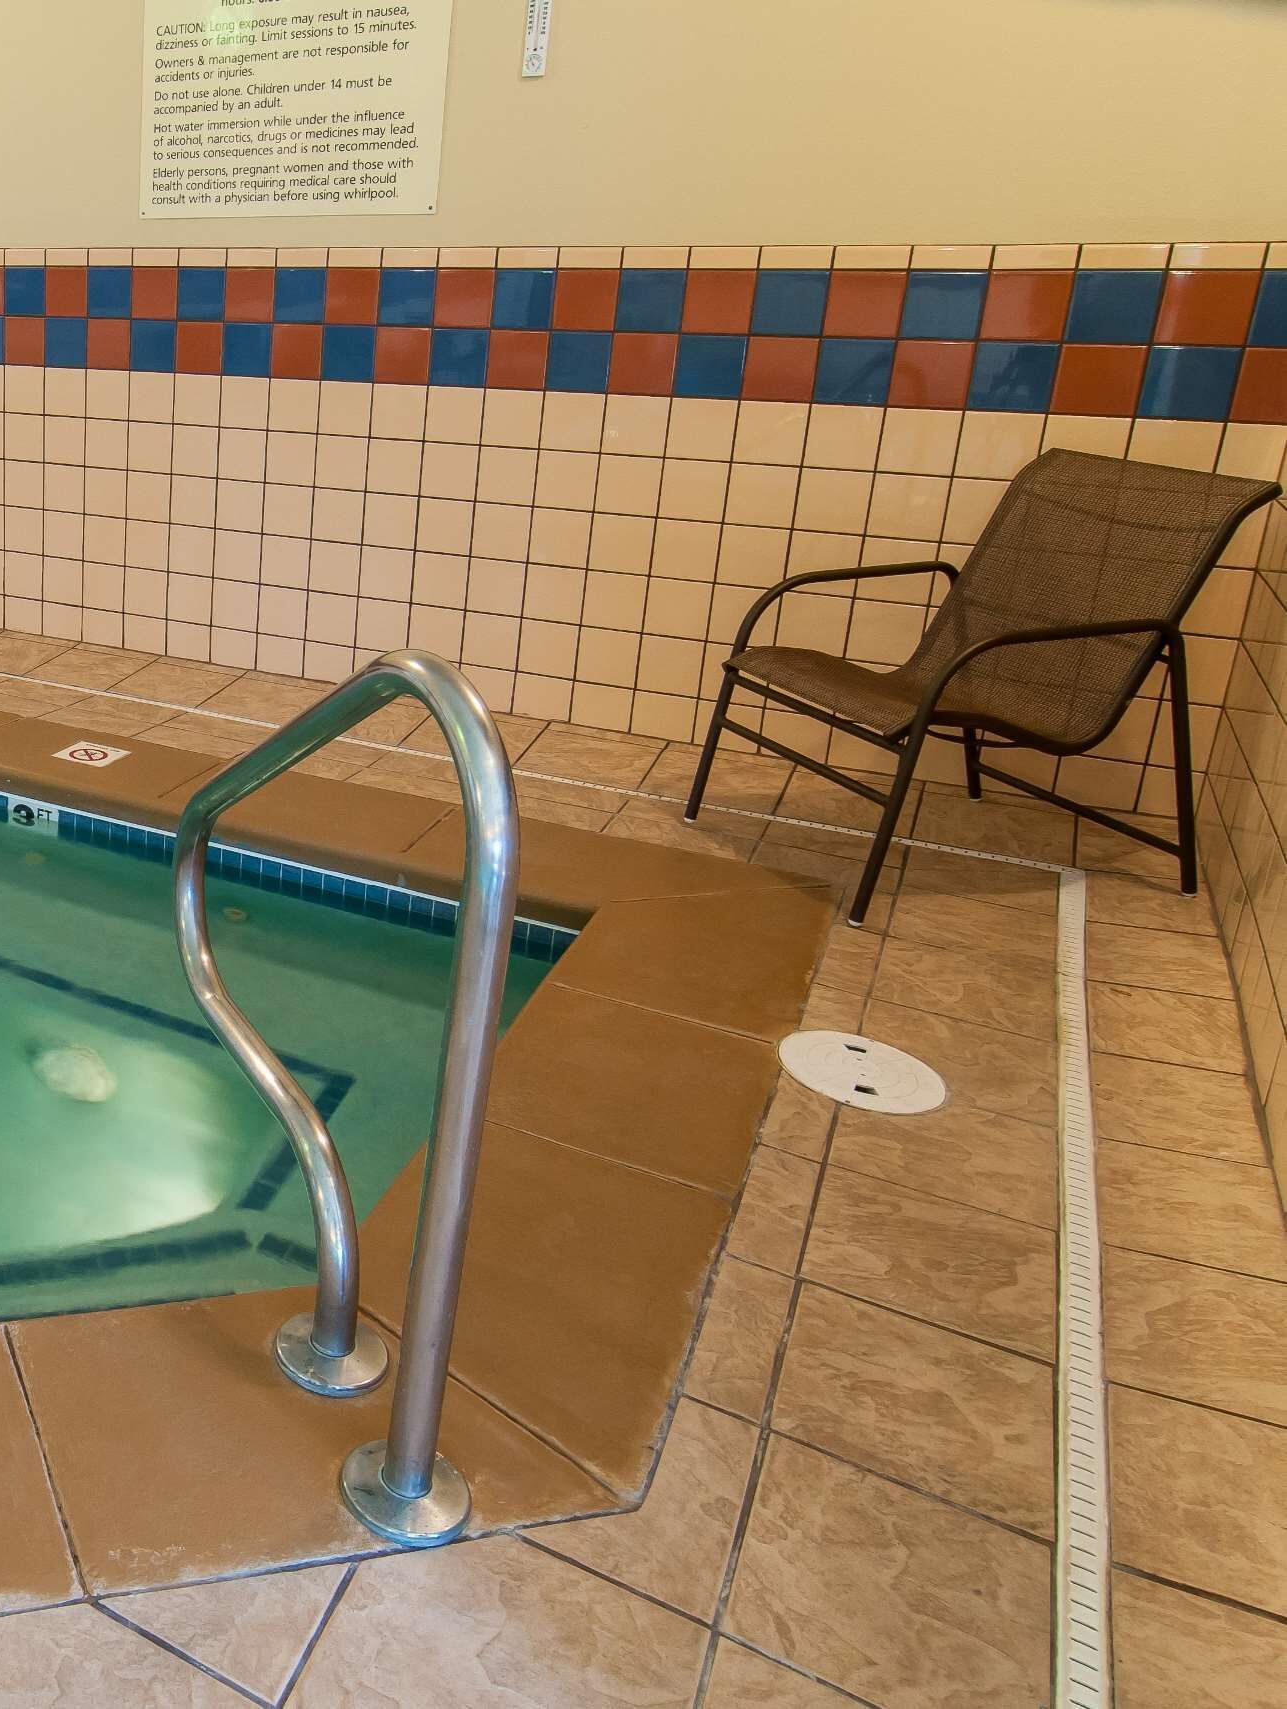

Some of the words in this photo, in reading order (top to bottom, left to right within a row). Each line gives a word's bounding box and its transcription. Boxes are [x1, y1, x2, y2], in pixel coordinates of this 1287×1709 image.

[209, 20, 235, 34] Long
[239, 15, 287, 31] exposure
[291, 14, 313, 27] may
[318, 9, 348, 23] result
[352, 9, 362, 20] in
[366, 5, 409, 19] nausea,
[156, 36, 198, 51] dizziness
[202, 36, 213, 47] or
[216, 33, 258, 47] fainting.
[261, 30, 287, 42] Limit
[291, 26, 333, 39] sessions
[337, 24, 348, 36] to
[354, 22, 365, 34] 15
[369, 19, 417, 33] minutes.
[155, 56, 194, 69] Owners
[198, 55, 205, 66] &
[209, 50, 278, 65] management
[282, 49, 298, 59] are
[303, 45, 322, 58] not
[325, 41, 388, 57] responsible
[392, 39, 409, 51] for
[154, 70, 199, 83] accidents
[203, 70, 214, 79] or
[218, 66, 254, 80] injuries.
[154, 91, 168, 101] Do
[172, 89, 189, 100] not
[193, 89, 209, 98] use
[213, 85, 242, 97] alone.
[247, 83, 289, 95] Children
[293, 80, 325, 92] under
[330, 79, 342, 89] 14
[346, 77, 374, 88] must
[378, 75, 392, 87] be
[154, 102, 218, 117] accompanied
[222, 100, 234, 111] by
[238, 101, 250, 109] an
[254, 97, 282, 108] adult.
[154, 123, 172, 133] Hot
[175, 122, 204, 132] water
[207, 118, 260, 130] immersion
[264, 116, 291, 128] while
[295, 113, 328, 125] under
[331, 112, 350, 123] the
[354, 109, 404, 122] influence
[154, 134, 163, 146] of
[167, 132, 202, 146] alcohol,
[207, 130, 253, 144] narcotics,
[257, 129, 286, 142] drugs
[290, 130, 301, 140] or
[305, 125, 358, 139] medicines
[362, 126, 386, 139] may
[390, 123, 414, 135] lead
[154, 150, 163, 160] to
[166, 148, 200, 159] serious
[203, 145, 273, 161] consequences
[277, 143, 297, 155] and
[301, 142, 308, 153] is
[312, 142, 330, 152] not
[334, 138, 418, 151] recommended.
[153, 166, 184, 179] Elderly
[188, 167, 228, 179] persons,
[232, 163, 280, 177] pregnant
[283, 163, 323, 173] women
[328, 160, 349, 171] and
[352, 158, 383, 170] those
[387, 156, 413, 169] with
[152, 180, 182, 191] health
[186, 177, 236, 190] conditions
[240, 176, 285, 191] requiring
[289, 175, 329, 187] medical
[334, 176, 356, 185] care
[360, 172, 396, 185] should
[152, 192, 185, 205] consult
[189, 192, 211, 203] with
[215, 194, 221, 202] a
[224, 190, 270, 205] physician
[273, 189, 308, 201] before
[312, 189, 339, 203] using
[343, 187, 398, 200] whirlpool.
[37, 808, 52, 821] FT
